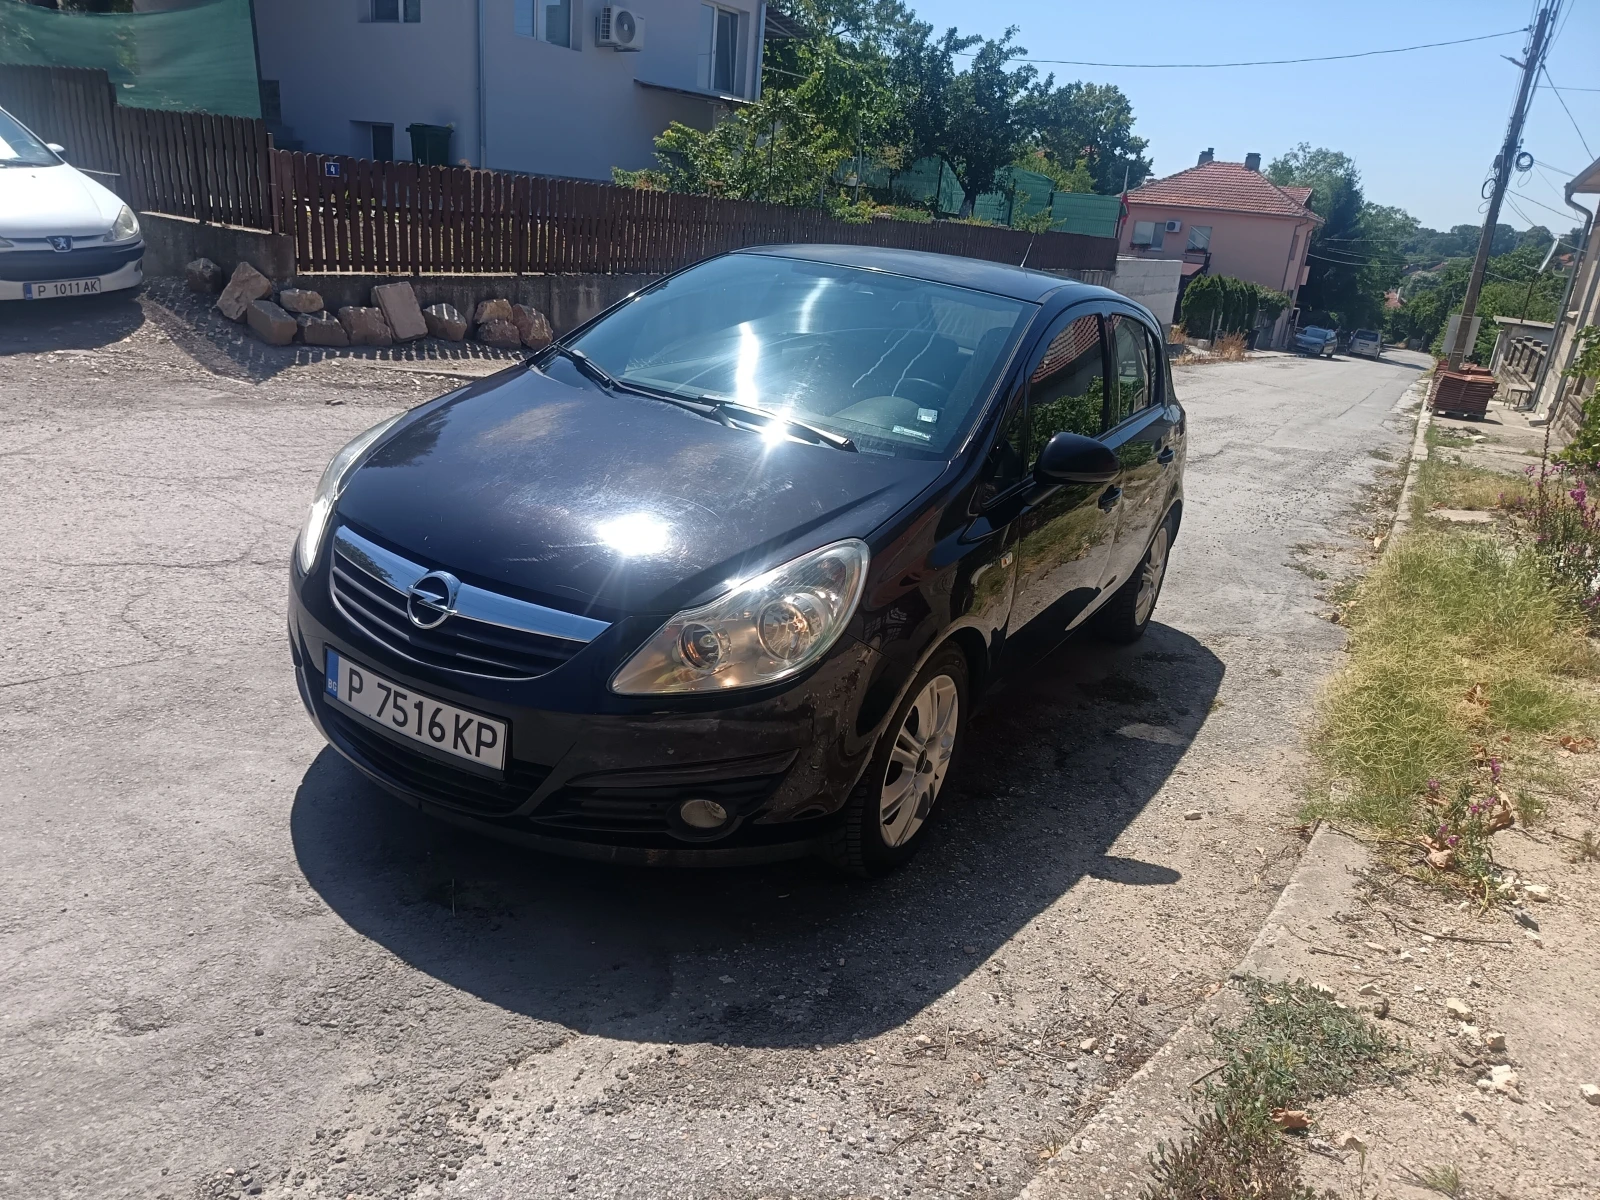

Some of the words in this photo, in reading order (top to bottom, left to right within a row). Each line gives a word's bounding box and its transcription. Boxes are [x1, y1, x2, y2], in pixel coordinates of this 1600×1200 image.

[38, 285, 46, 296] P
[328, 679, 337, 691] BG
[348, 668, 364, 702] P
